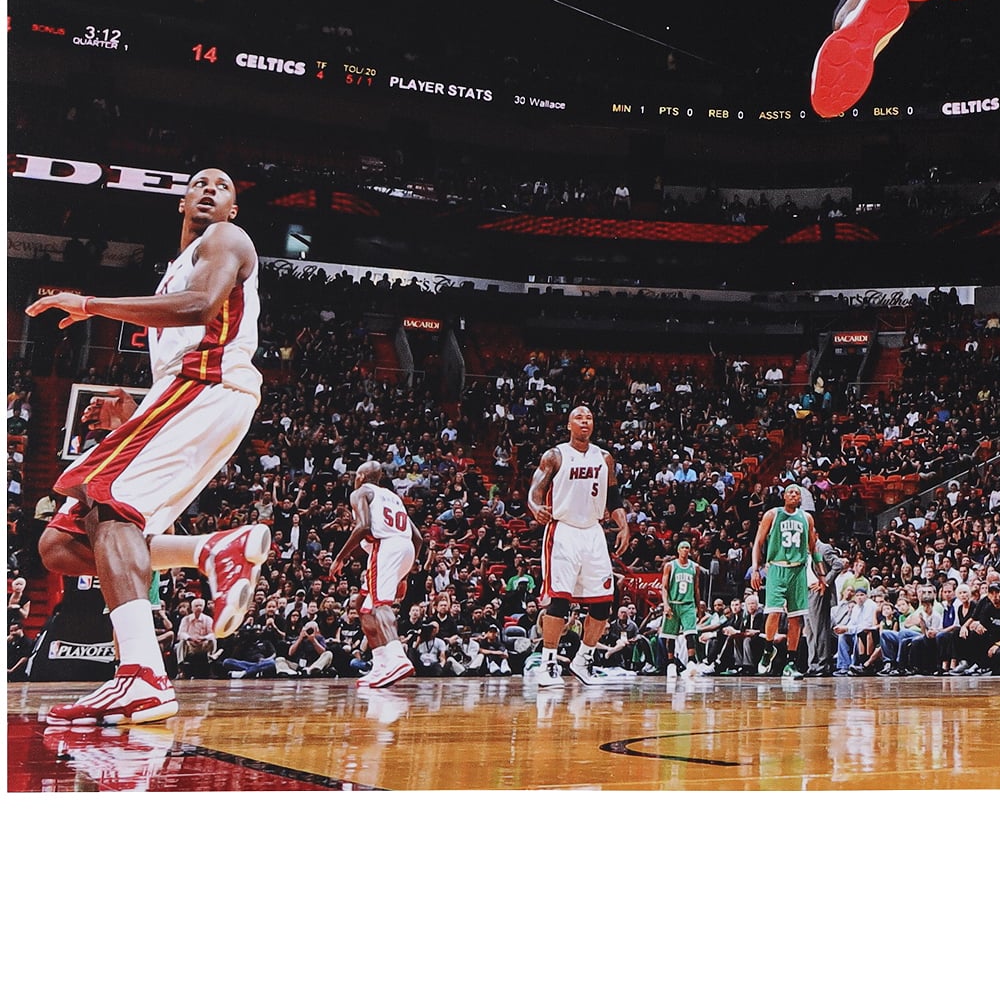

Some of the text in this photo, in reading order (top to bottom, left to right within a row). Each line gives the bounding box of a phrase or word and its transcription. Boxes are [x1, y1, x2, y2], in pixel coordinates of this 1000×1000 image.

[85, 26, 122, 43] 3:12
[73, 37, 118, 50] QUARTER
[192, 44, 218, 63] 14
[235, 53, 306, 76] CELTICS
[390, 76, 494, 102] PLAYER STATS
[514, 95, 566, 110] 30 Wallace
[942, 97, 1000, 116] CELTICS
[612, 104, 631, 113] MIN
[640, 106, 645, 114] 1
[659, 106, 679, 116] PTS
[687, 108, 693, 117] 0
[709, 109, 729, 119] REB
[738, 111, 744, 120] 0
[759, 111, 792, 120] ASSTS
[799, 110, 806, 119] 0
[852, 108, 859, 118] 0
[874, 106, 899, 116] BLKS
[907, 106, 913, 115] 0
[403, 319, 440, 329] BACARDI
[569, 464, 602, 480] HEAT
[591, 482, 599, 497] 5
[383, 507, 408, 532] 50
[781, 531, 802, 548] 34
